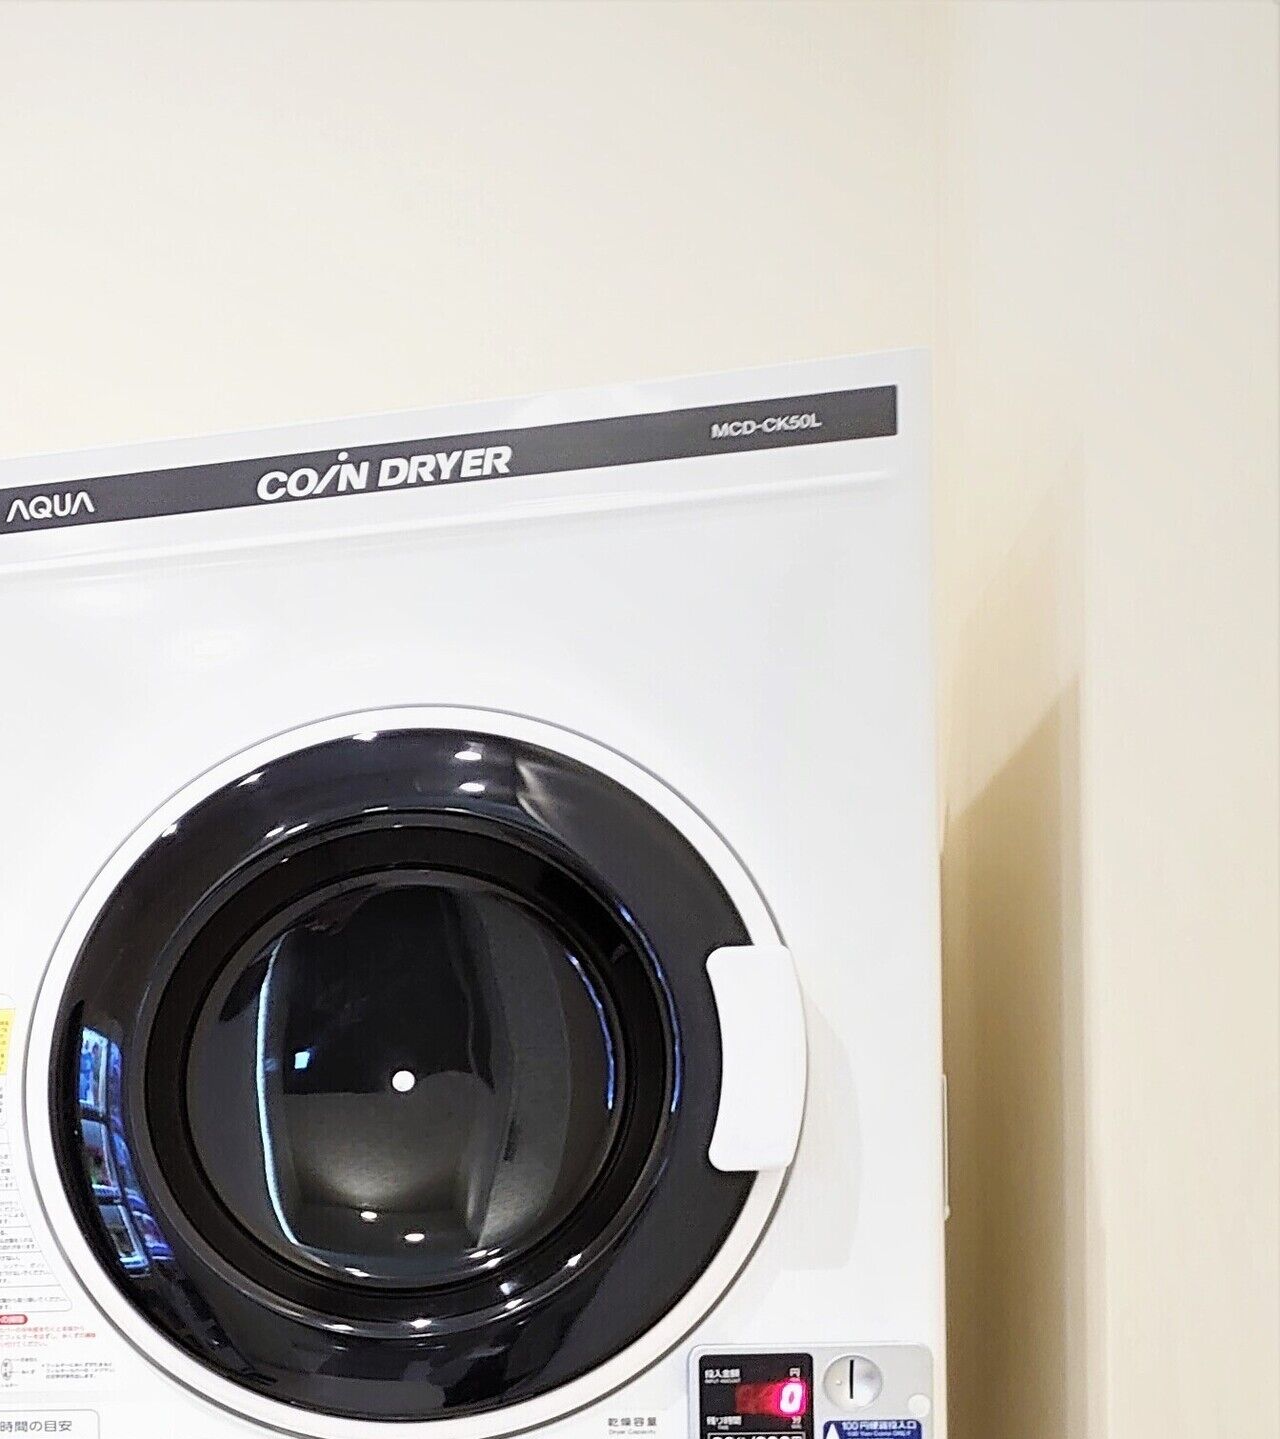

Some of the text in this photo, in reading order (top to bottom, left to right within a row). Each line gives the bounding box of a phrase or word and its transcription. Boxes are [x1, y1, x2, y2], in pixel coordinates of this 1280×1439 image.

[710, 411, 822, 440] MCD-CK50L
[256, 445, 512, 502] COIN DRYER
[6, 491, 94, 523] AQUA
[779, 1384, 803, 1413] 0
